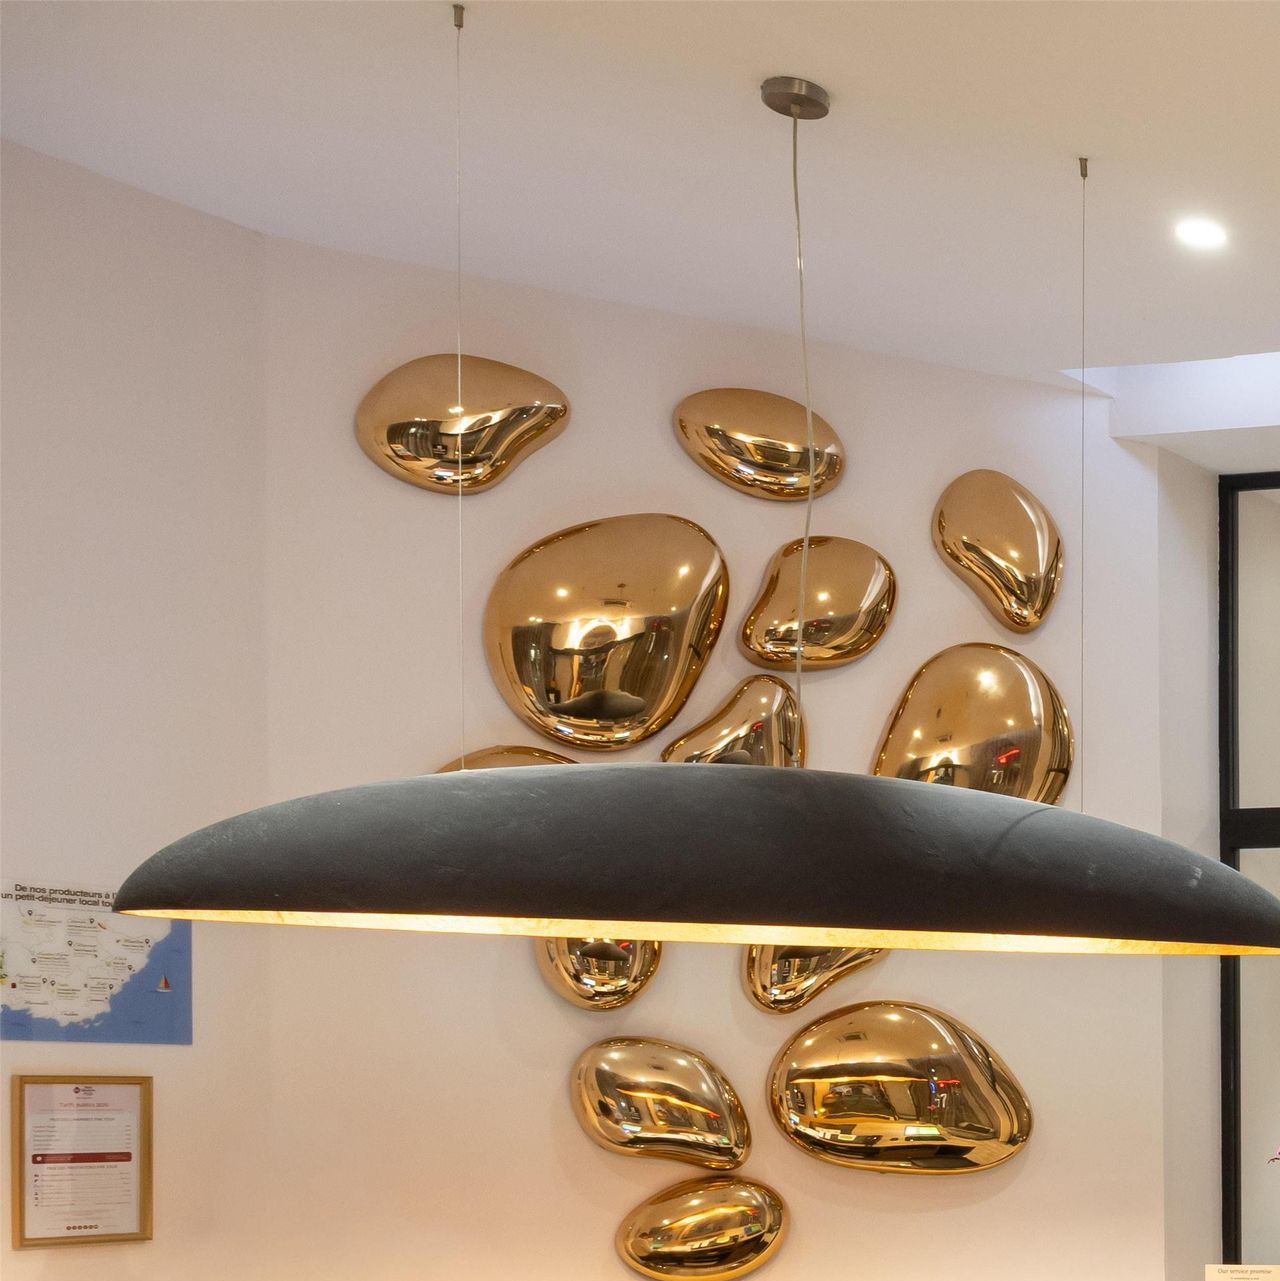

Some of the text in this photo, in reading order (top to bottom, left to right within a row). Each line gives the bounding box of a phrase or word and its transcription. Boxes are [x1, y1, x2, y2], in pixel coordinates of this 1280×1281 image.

[14, 884, 28, 892] De
[30, 886, 47, 894] nos
[48, 888, 102, 898] producteurs
[79, 898, 100, 906] local
